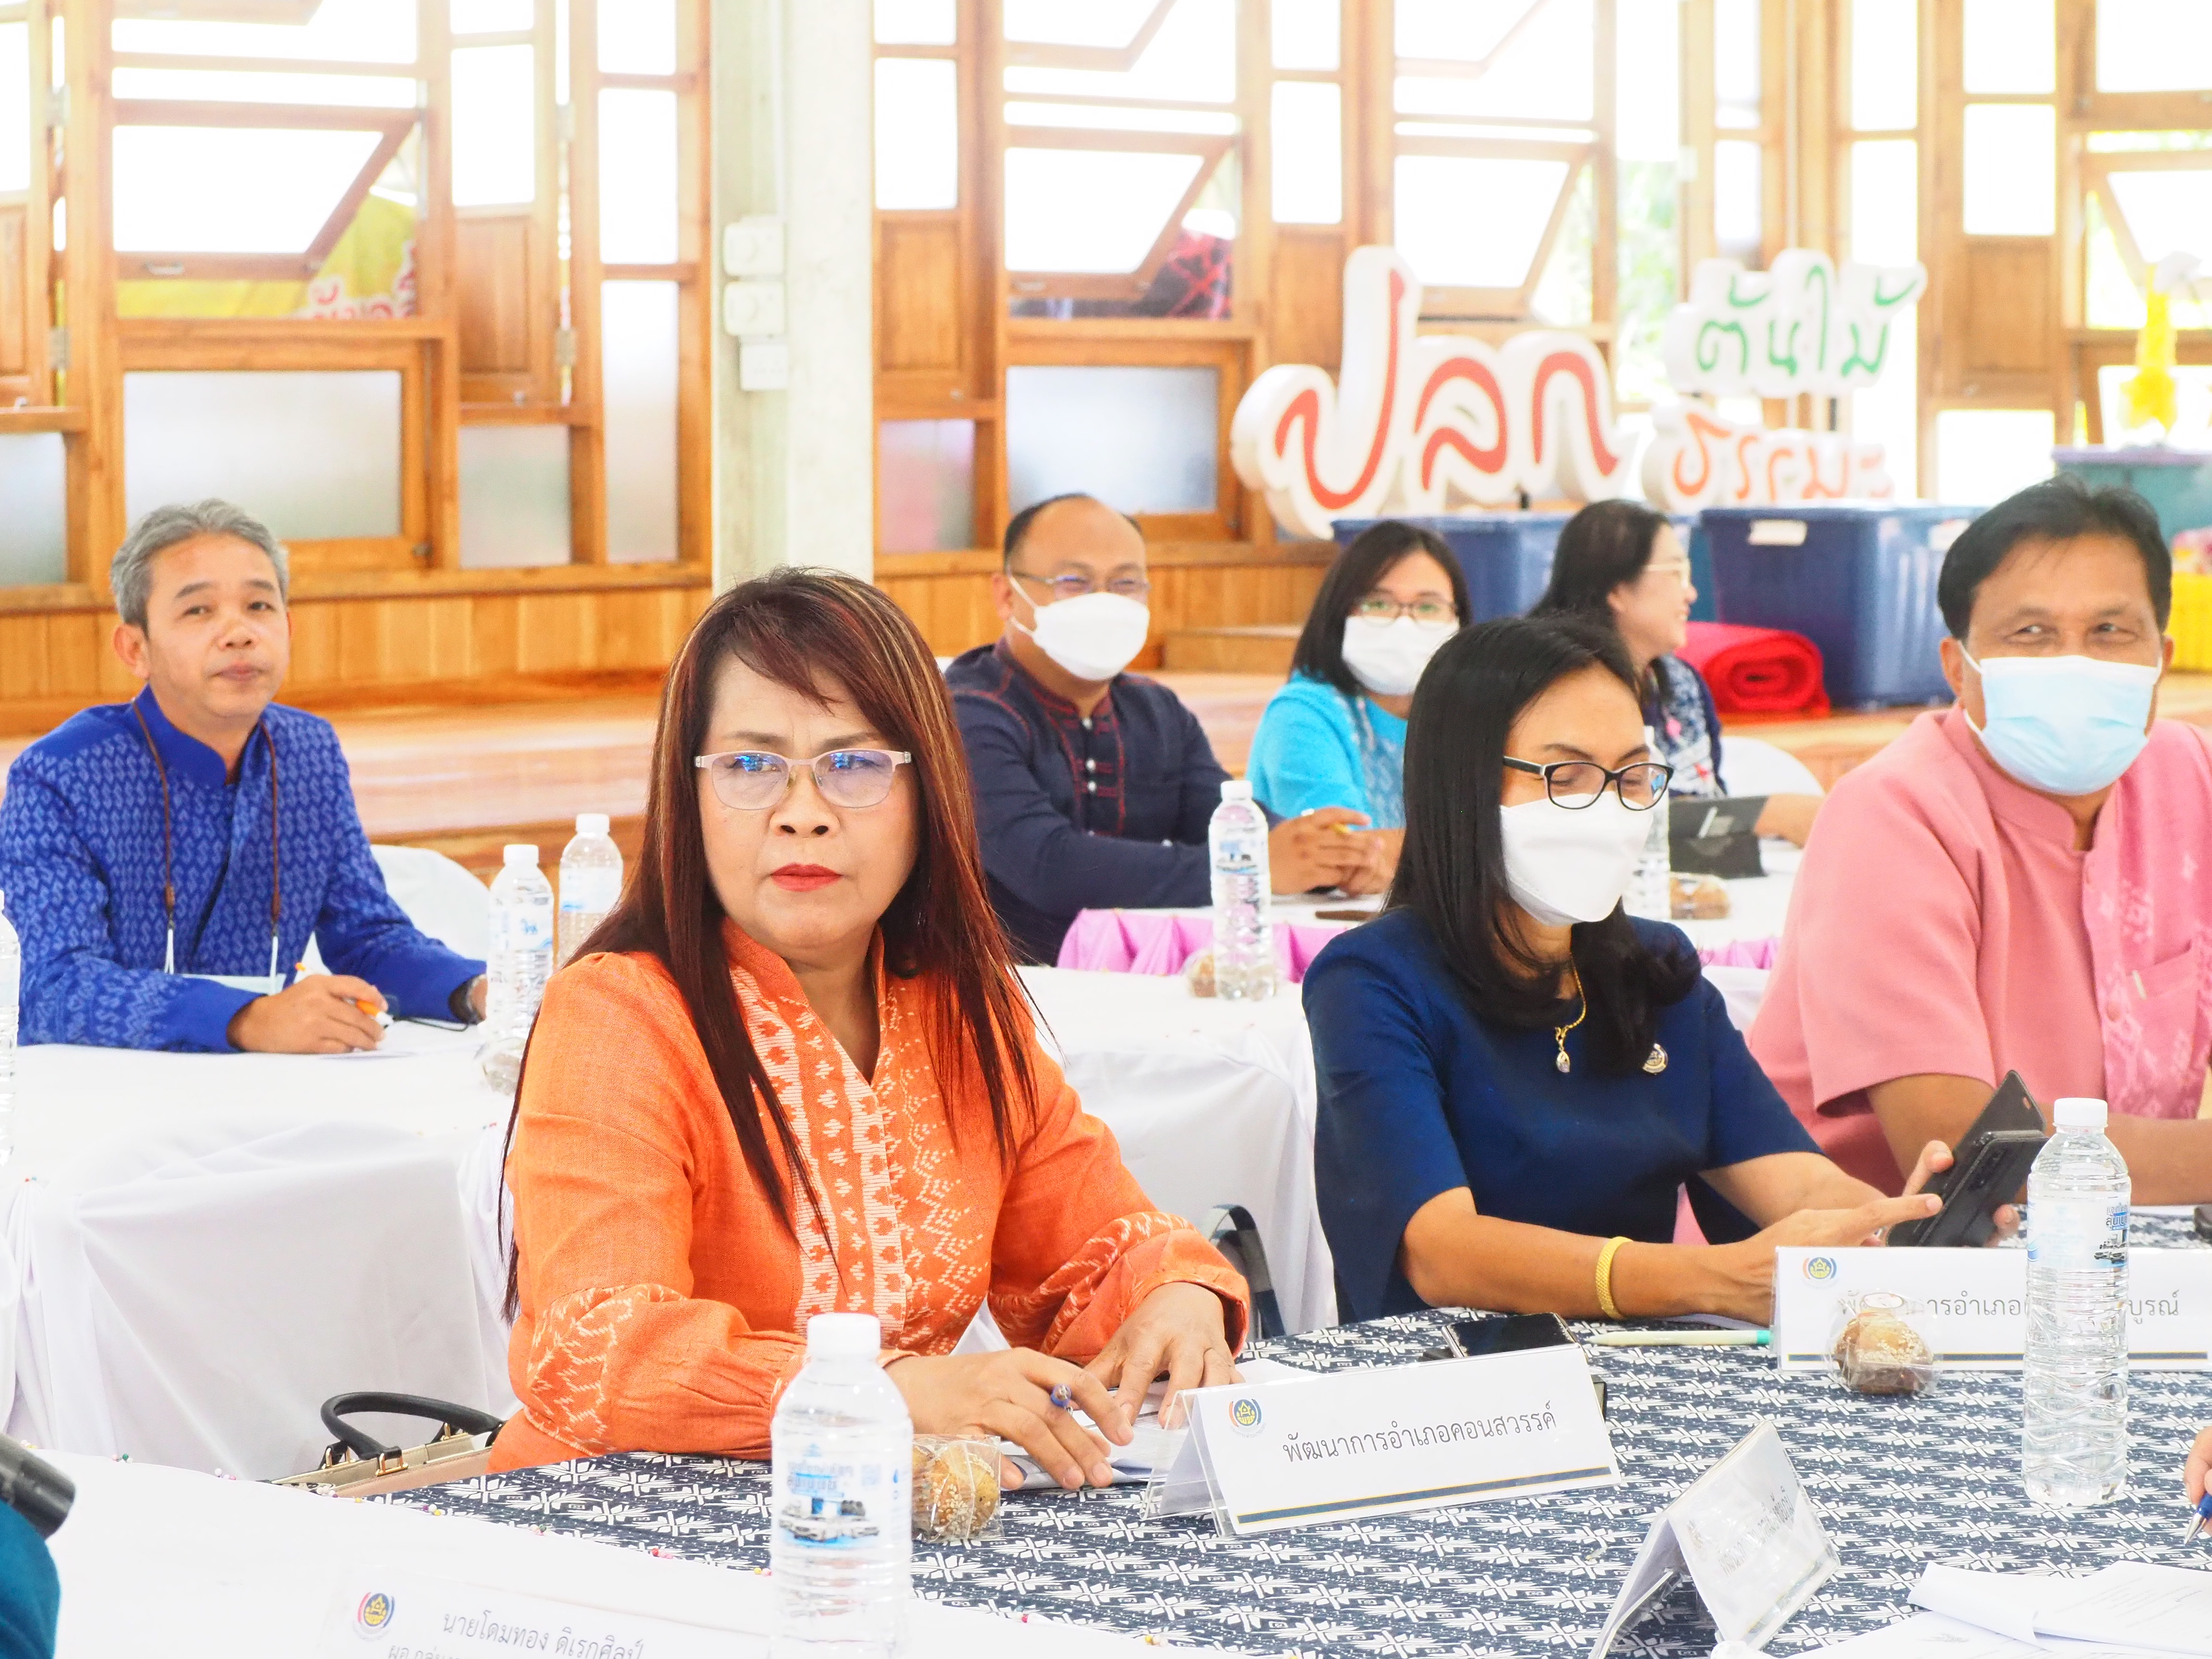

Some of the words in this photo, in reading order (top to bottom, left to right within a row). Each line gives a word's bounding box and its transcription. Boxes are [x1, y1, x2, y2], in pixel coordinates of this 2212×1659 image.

[1282, 1400, 1557, 1463] พัฒนาการอำเภอคอนสวรรค์
[444, 1610, 549, 1650] นายโดมทอง
